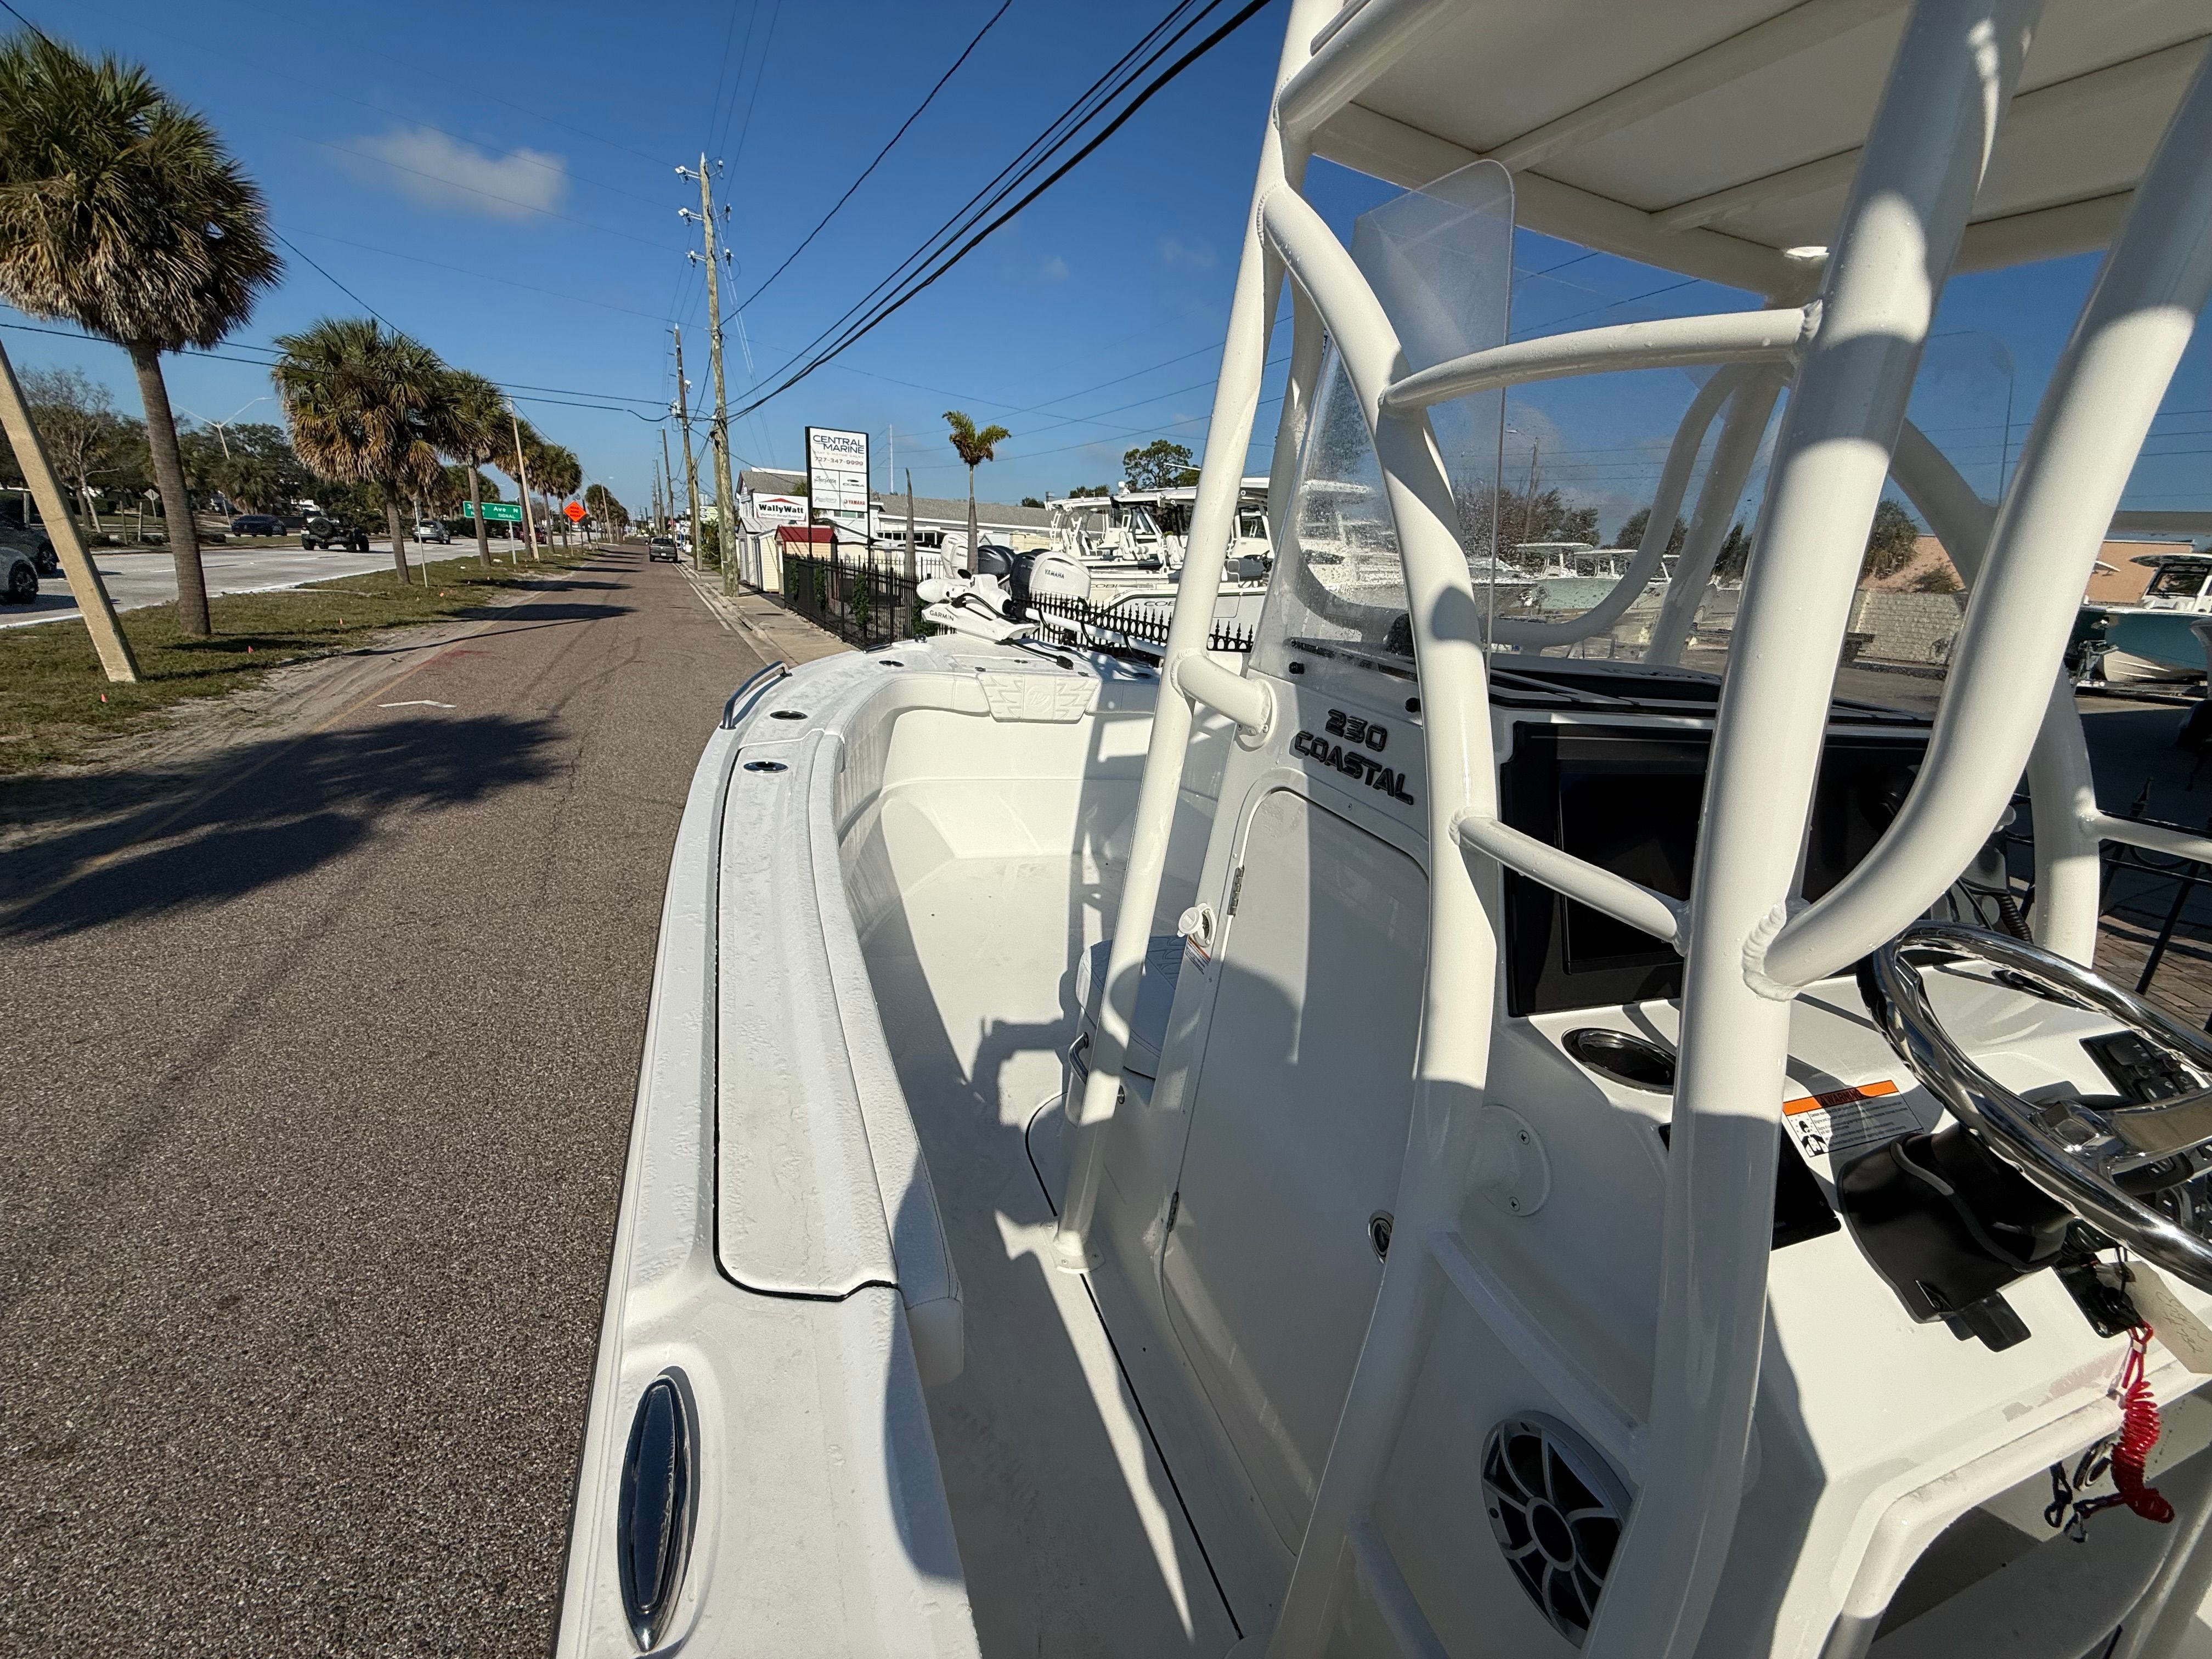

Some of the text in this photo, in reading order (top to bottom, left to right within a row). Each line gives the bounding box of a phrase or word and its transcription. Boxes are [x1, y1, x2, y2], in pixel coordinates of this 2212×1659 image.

[812, 435, 865, 447] CENTRAL
[823, 443, 865, 454] MARINE
[758, 504, 804, 514] WallyWatt
[1045, 568, 1064, 579] YAMAHA
[929, 610, 954, 622] GARMIN
[1325, 709, 1387, 752] 230
[1294, 730, 1414, 805] COASTAL
[1825, 1090, 1862, 1105] WARNING
